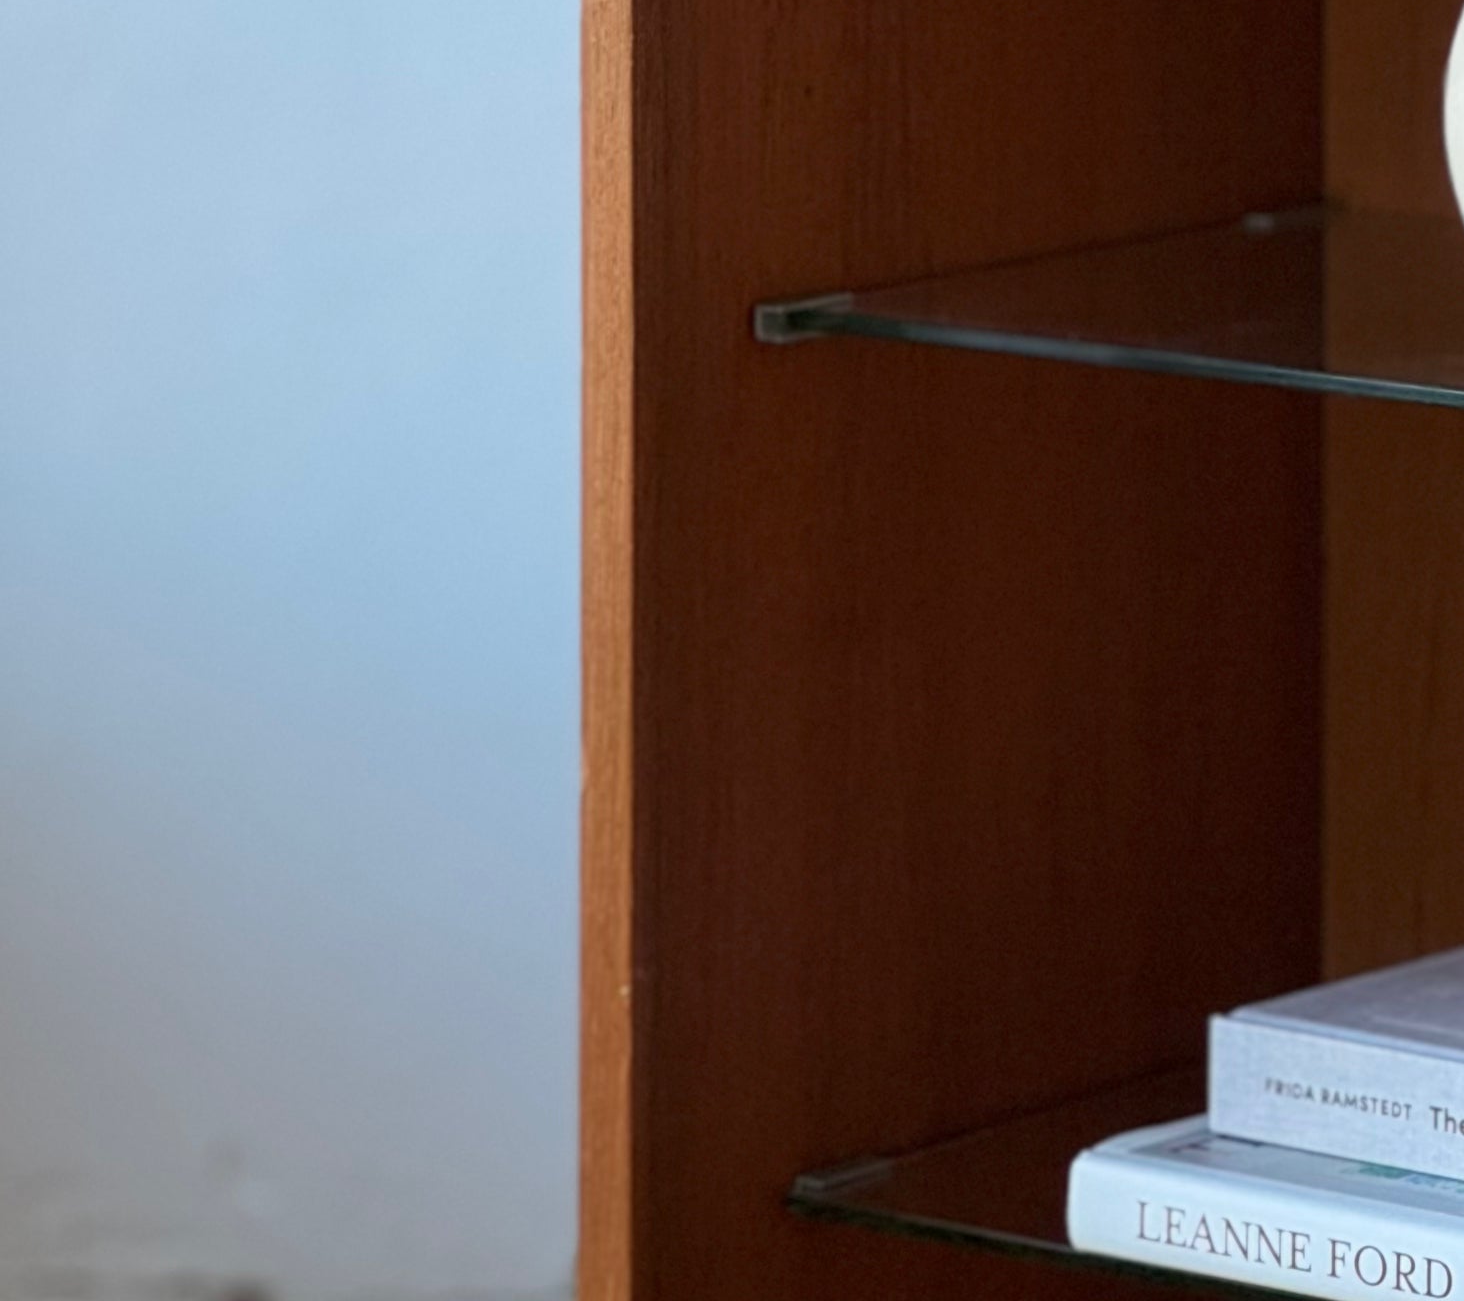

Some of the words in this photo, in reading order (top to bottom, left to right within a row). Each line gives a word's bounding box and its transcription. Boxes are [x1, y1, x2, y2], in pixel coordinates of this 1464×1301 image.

[1263, 1077, 1315, 1103] FRIDA
[1320, 1086, 1412, 1121] RAMSTEDT
[1136, 1200, 1312, 1274] LEANNE
[1327, 1237, 1453, 1300] FORD
